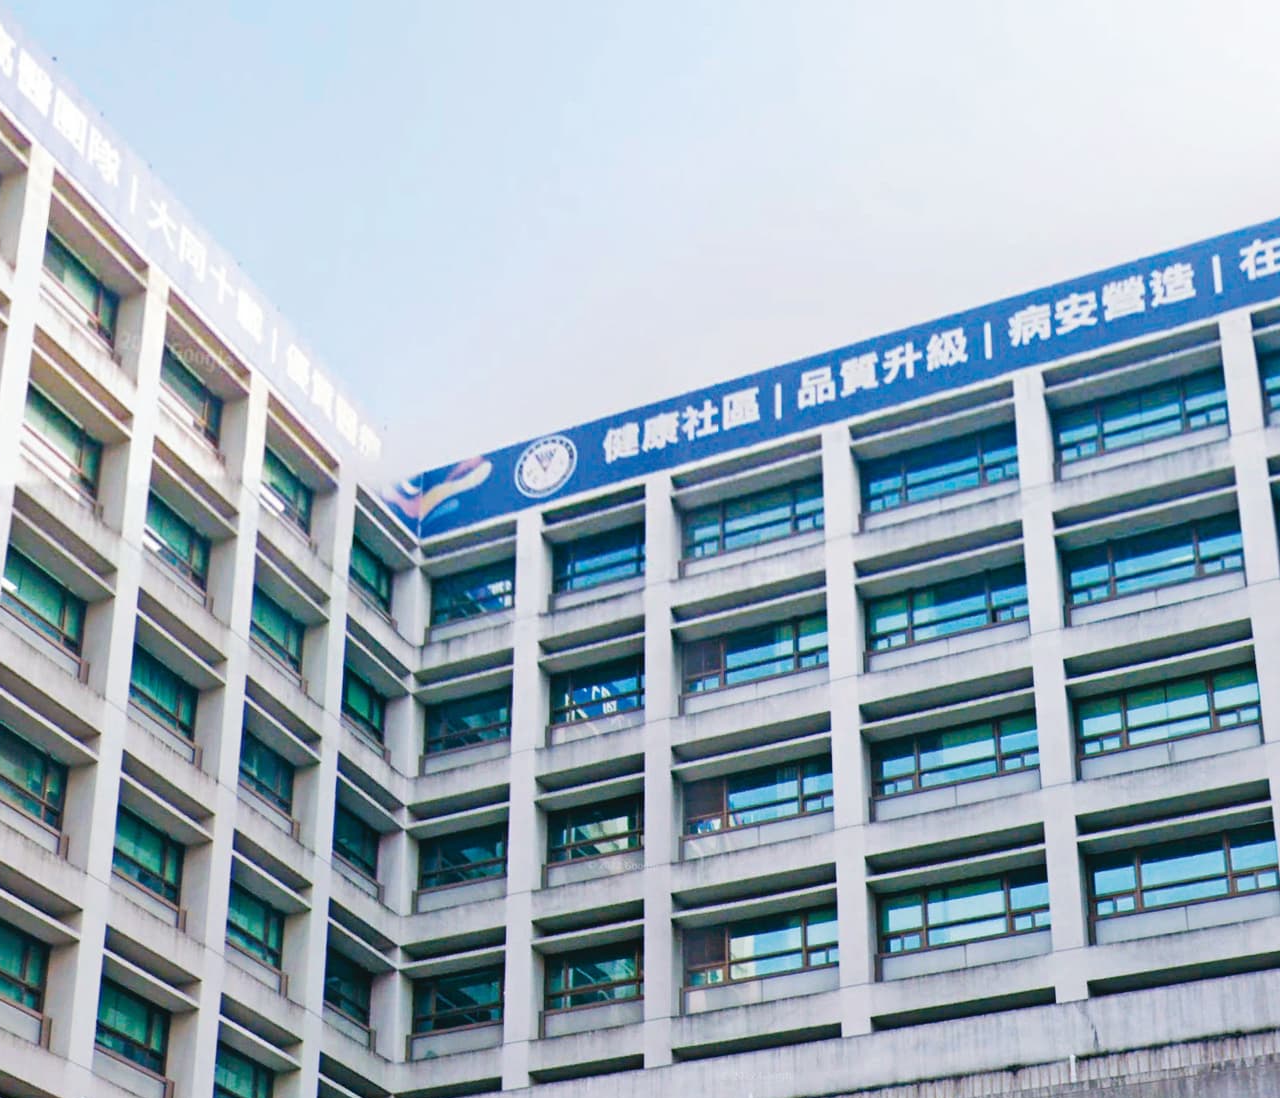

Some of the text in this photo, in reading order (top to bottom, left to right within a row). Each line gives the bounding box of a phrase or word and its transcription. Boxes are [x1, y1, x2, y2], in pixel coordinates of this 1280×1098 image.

[1007, 262, 1198, 348] 病安營造
[796, 326, 970, 409] 品質升級
[602, 389, 760, 465] 健康社區
